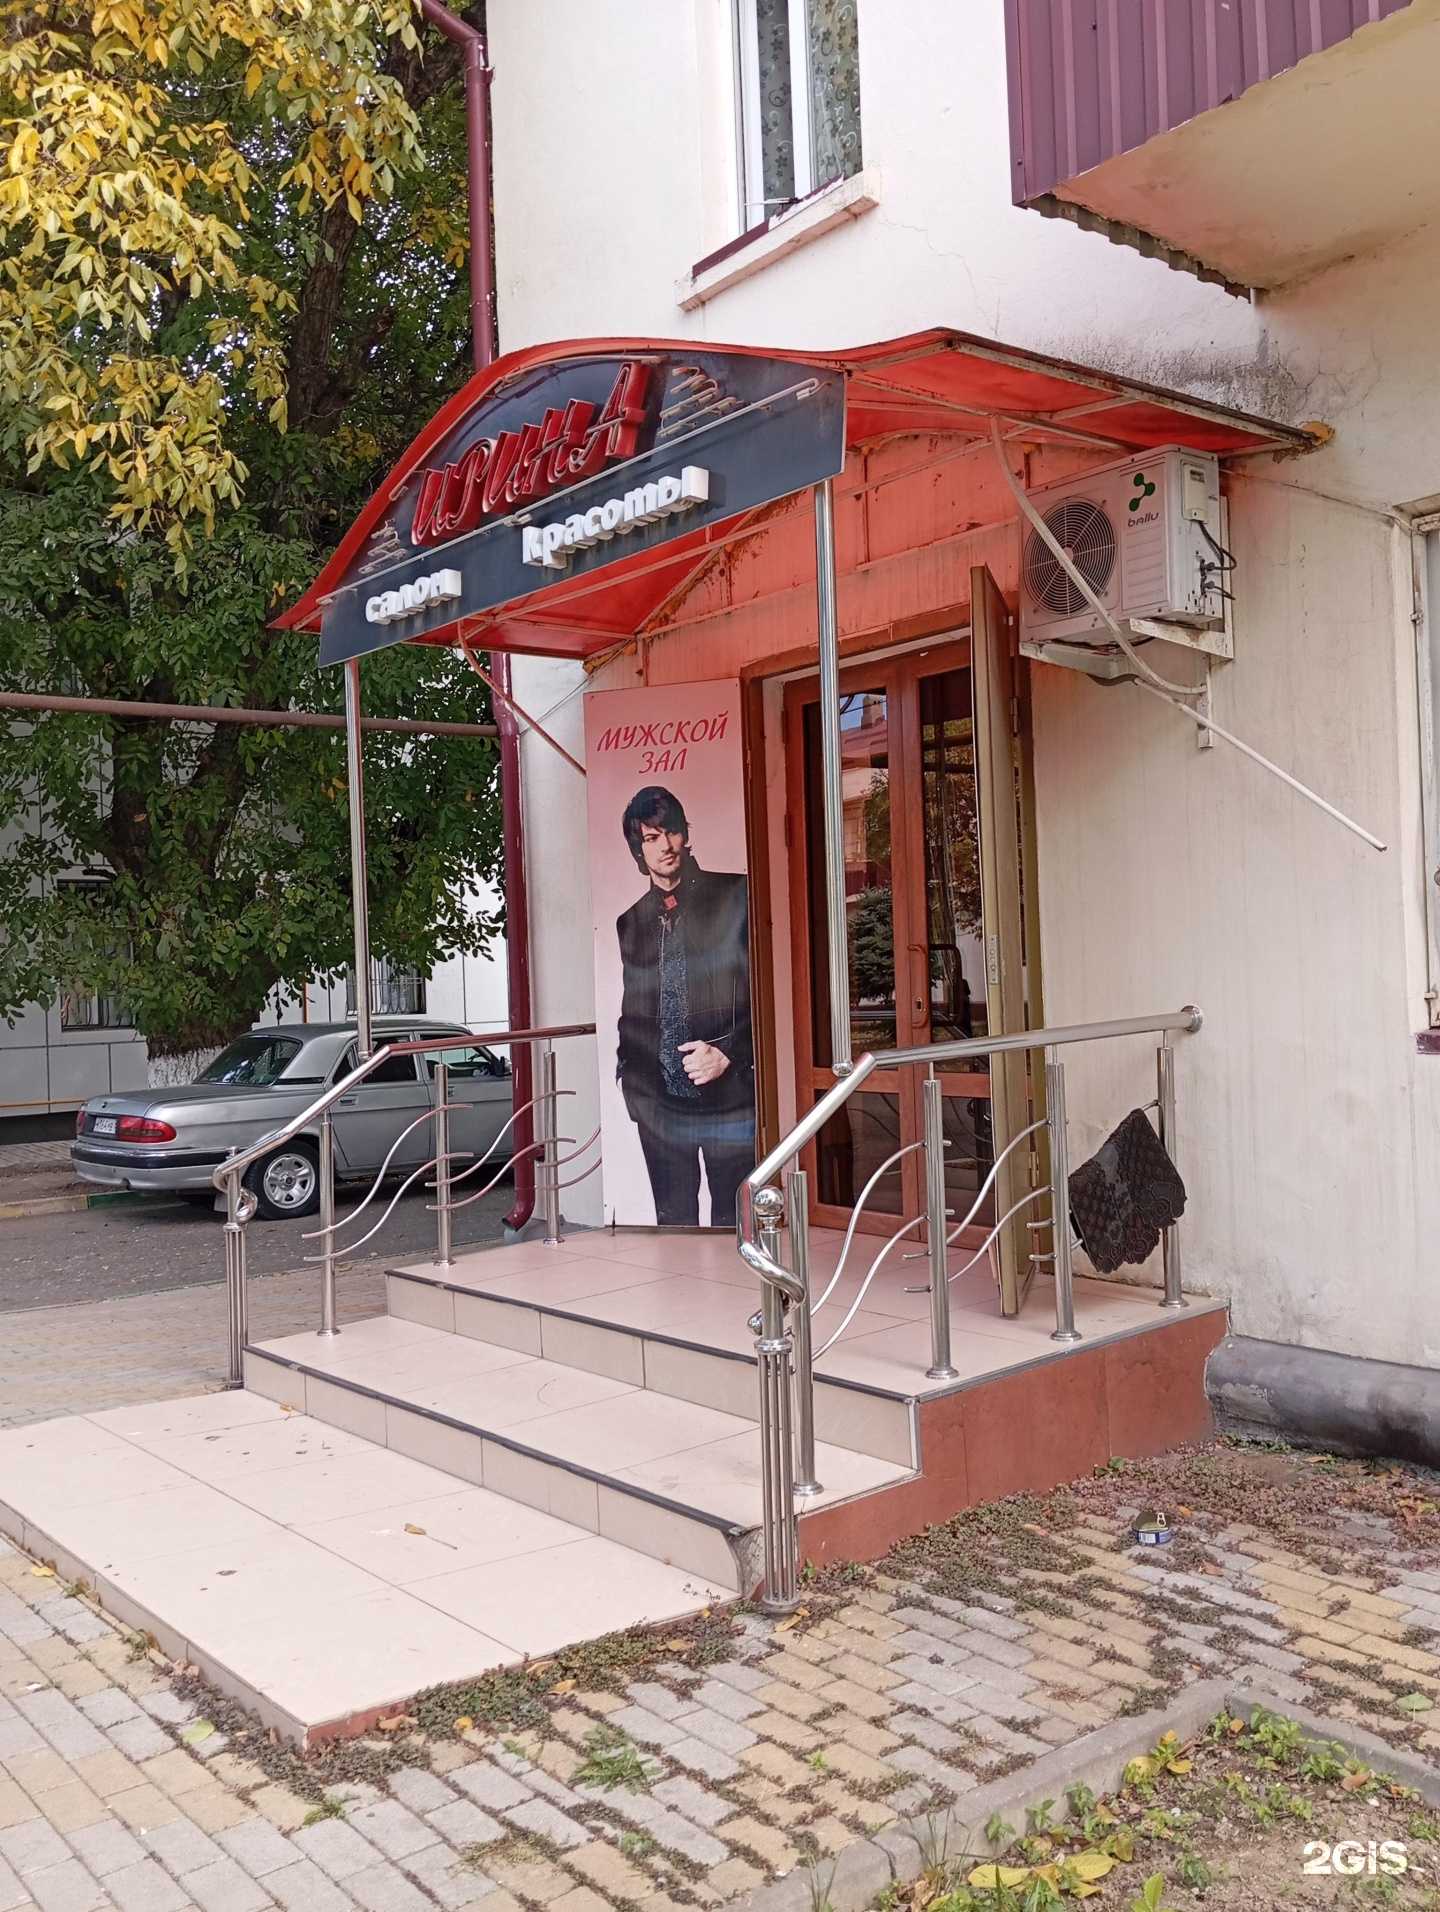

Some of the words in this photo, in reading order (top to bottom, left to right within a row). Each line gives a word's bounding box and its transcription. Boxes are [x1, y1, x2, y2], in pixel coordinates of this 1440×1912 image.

[365, 568, 462, 625] салон
[597, 710, 729, 752] МУЖСКОЙ
[638, 748, 688, 774] ЗАЛ
